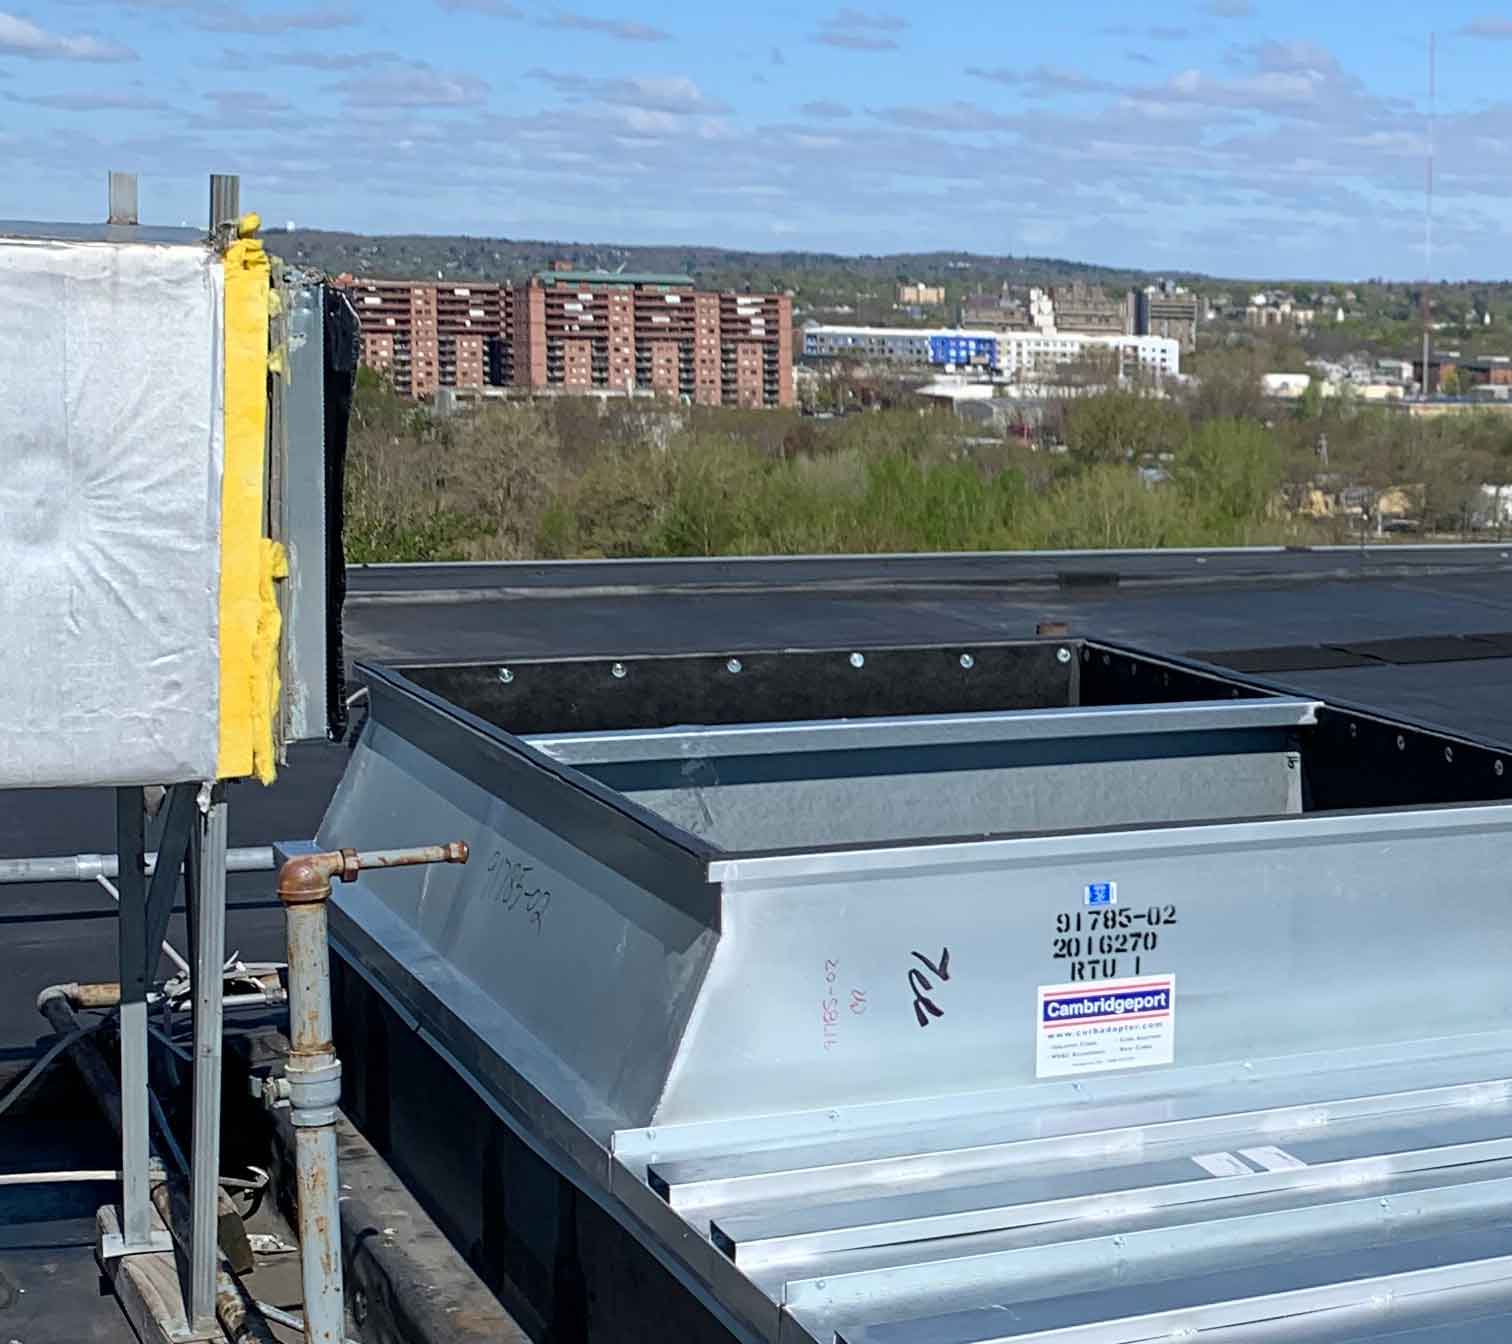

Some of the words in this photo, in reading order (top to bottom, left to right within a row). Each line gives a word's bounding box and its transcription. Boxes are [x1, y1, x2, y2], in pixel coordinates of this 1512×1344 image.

[1056, 904, 1177, 933] 91785-02
[1053, 931, 1157, 958] 2016270
[1071, 958, 1116, 981] RTU
[1047, 992, 1167, 1018] Cambridgeport
